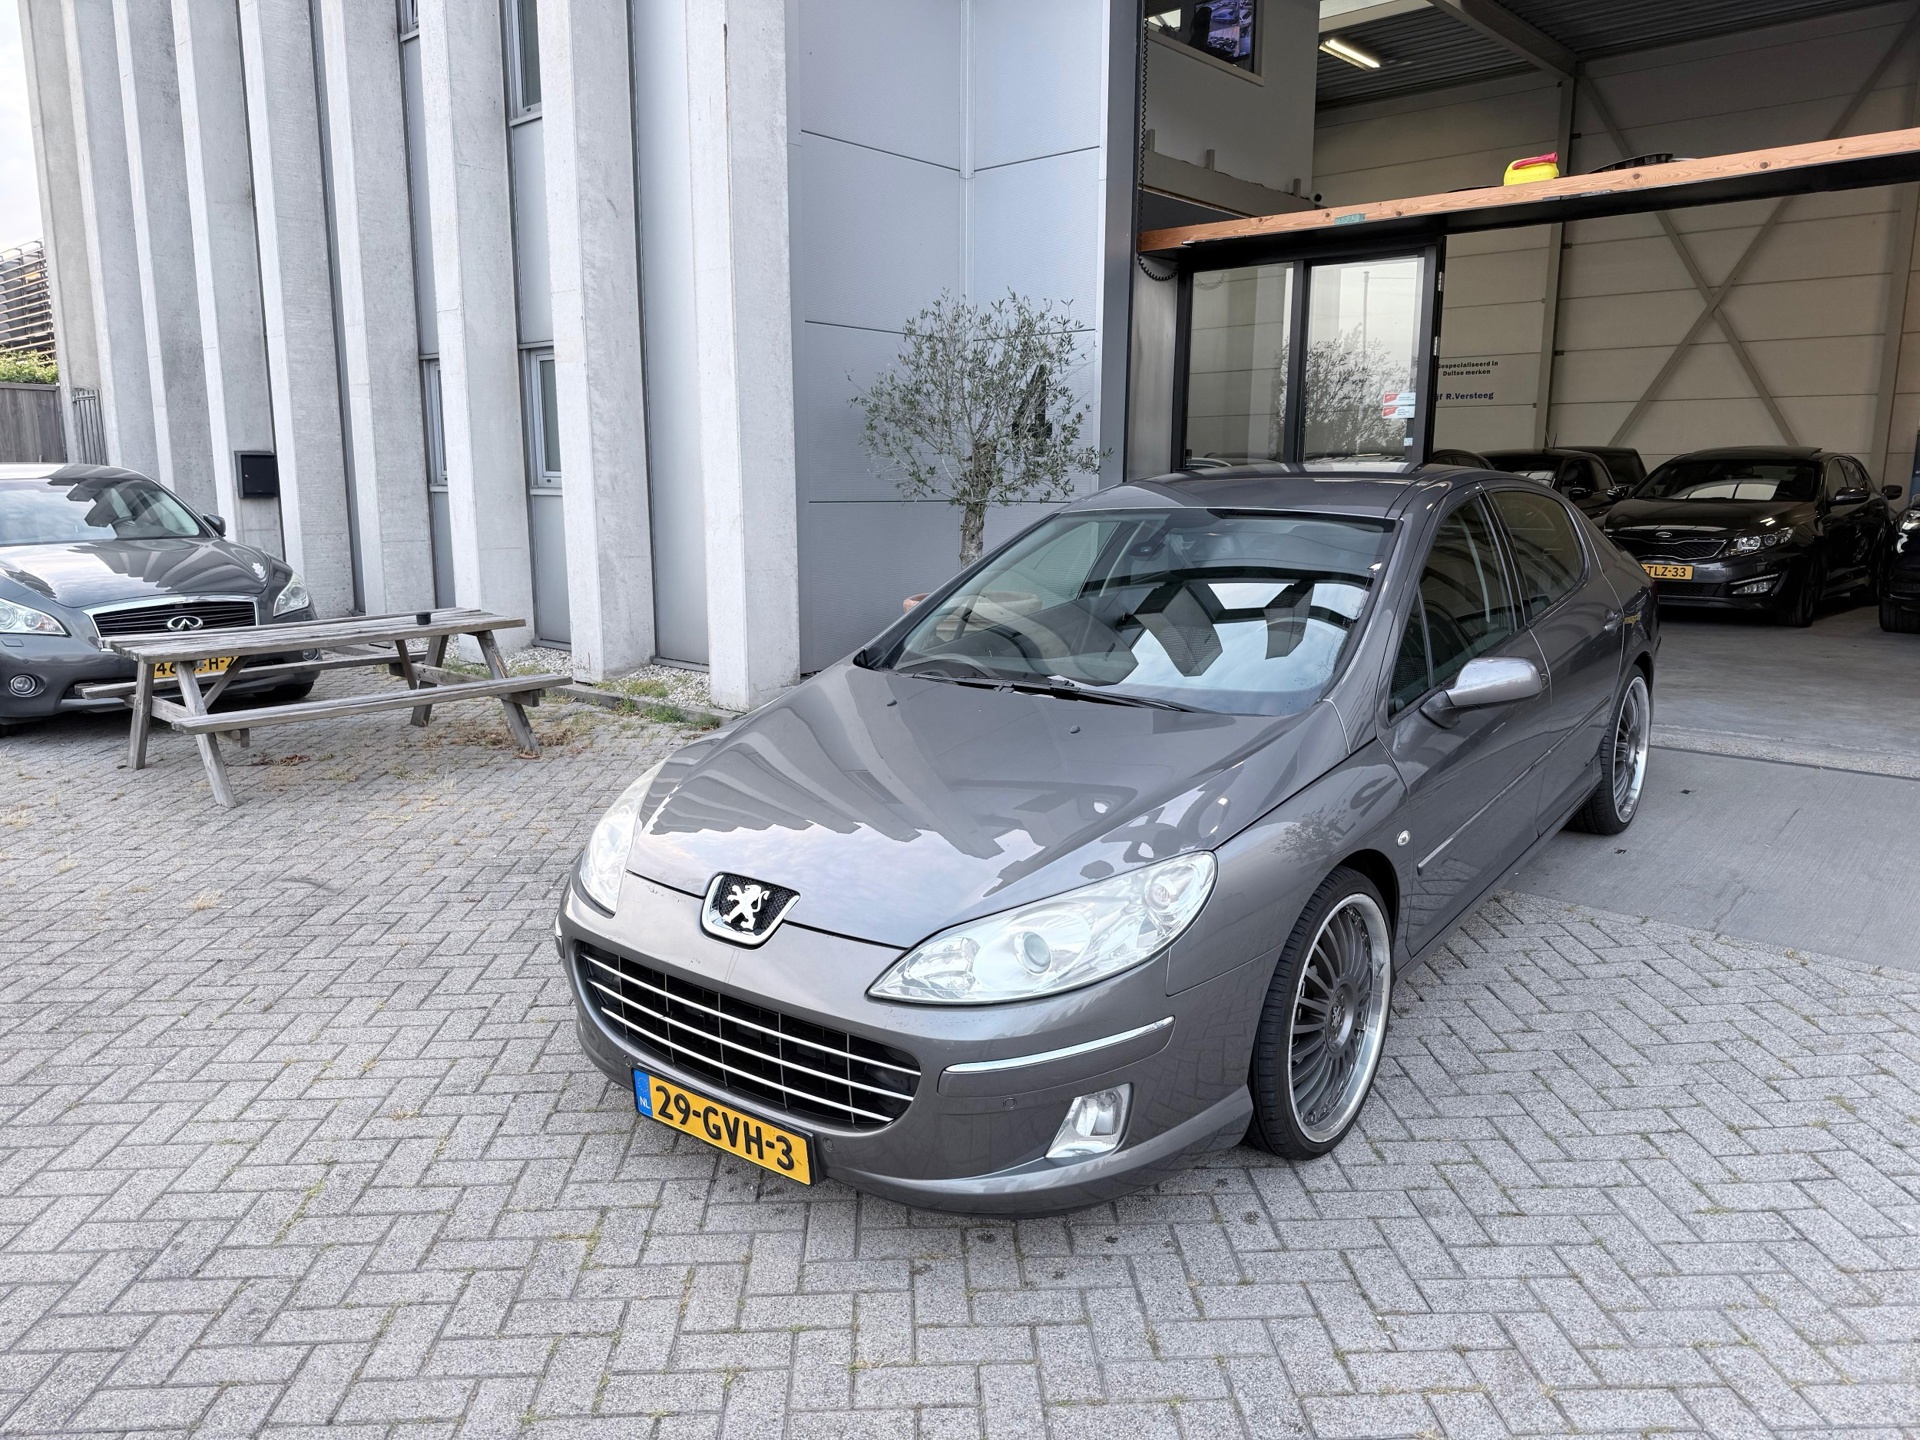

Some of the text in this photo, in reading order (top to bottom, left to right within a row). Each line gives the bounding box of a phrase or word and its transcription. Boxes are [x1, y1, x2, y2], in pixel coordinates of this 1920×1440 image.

[1643, 565, 1687, 577] -TLZ-33
[639, 1095, 651, 1110] NL
[655, 1084, 795, 1171] 29-GVH-3
